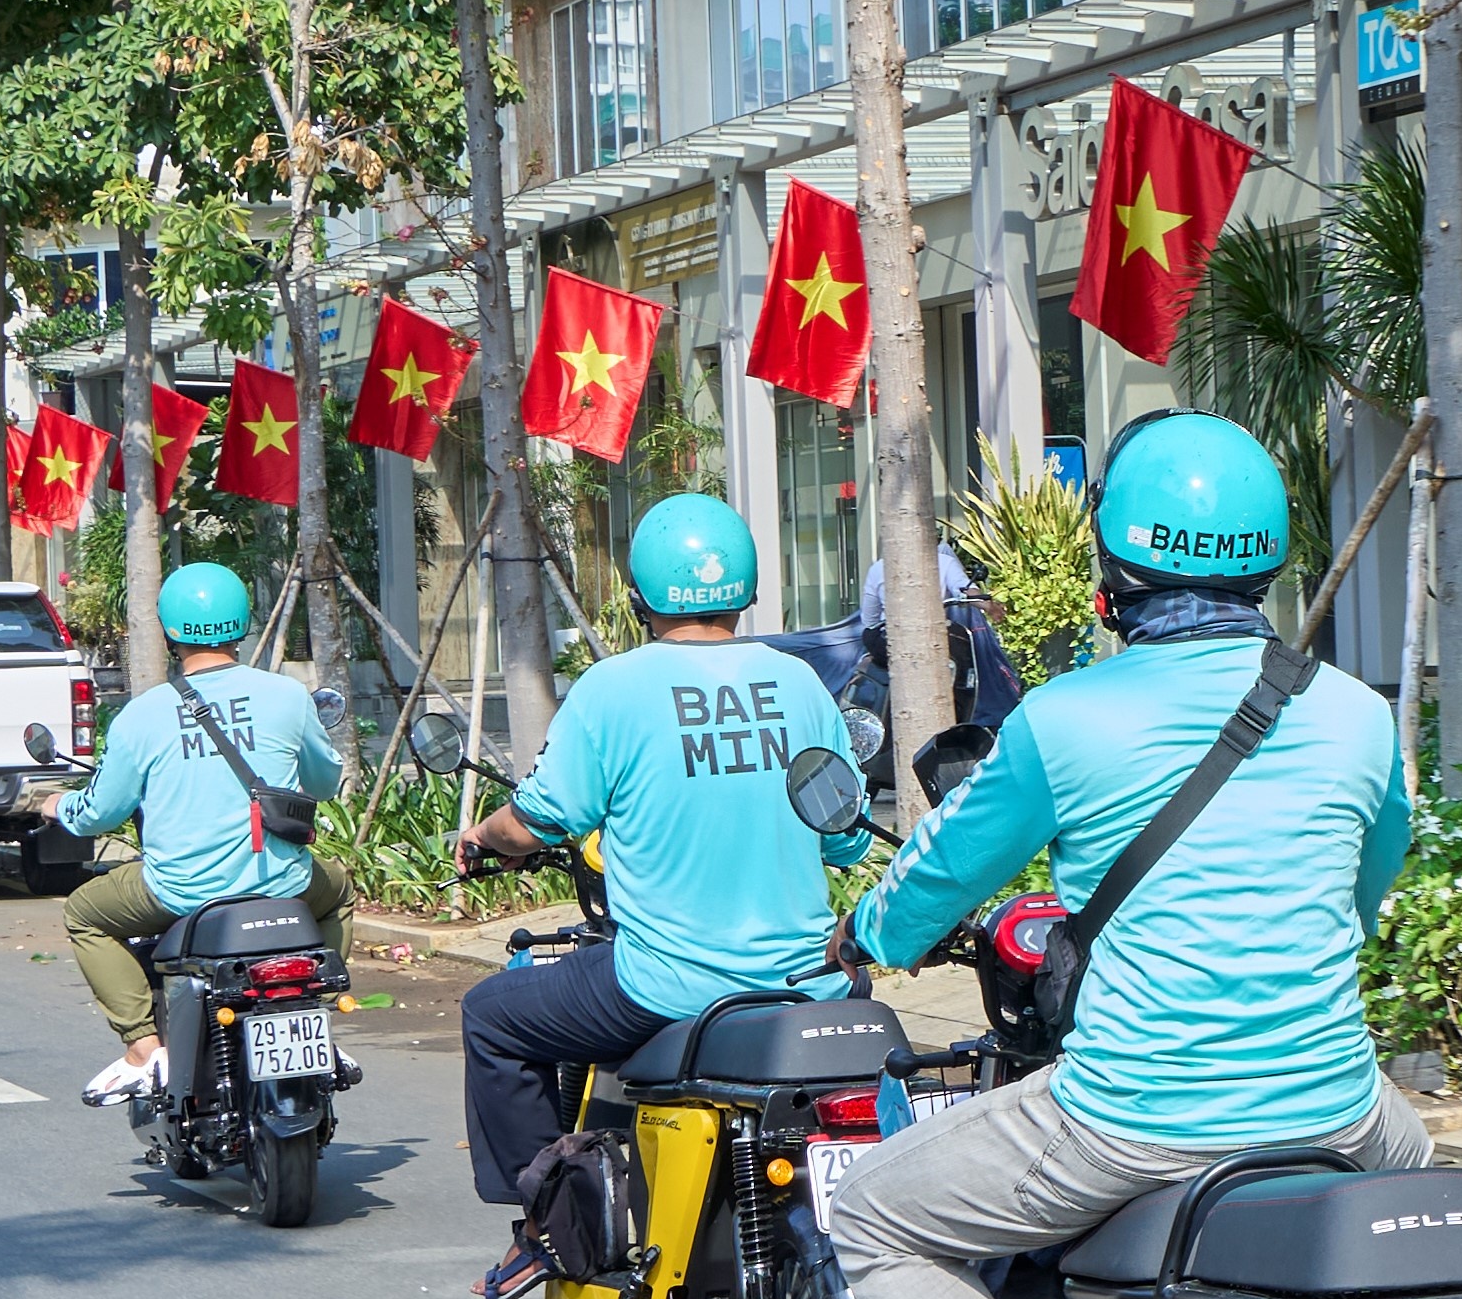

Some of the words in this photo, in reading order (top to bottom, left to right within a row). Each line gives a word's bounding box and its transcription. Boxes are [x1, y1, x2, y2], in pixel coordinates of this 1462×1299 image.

[1150, 523, 1269, 559] BAEMIN
[667, 579, 745, 604] BAEMIN
[183, 618, 240, 636] BAEMIN
[671, 681, 785, 727] BAE
[681, 726, 789, 778] MIN
[241, 916, 300, 930] SELEX
[801, 1024, 885, 1039] SELEX
[254, 1043, 328, 1076] 752.06
